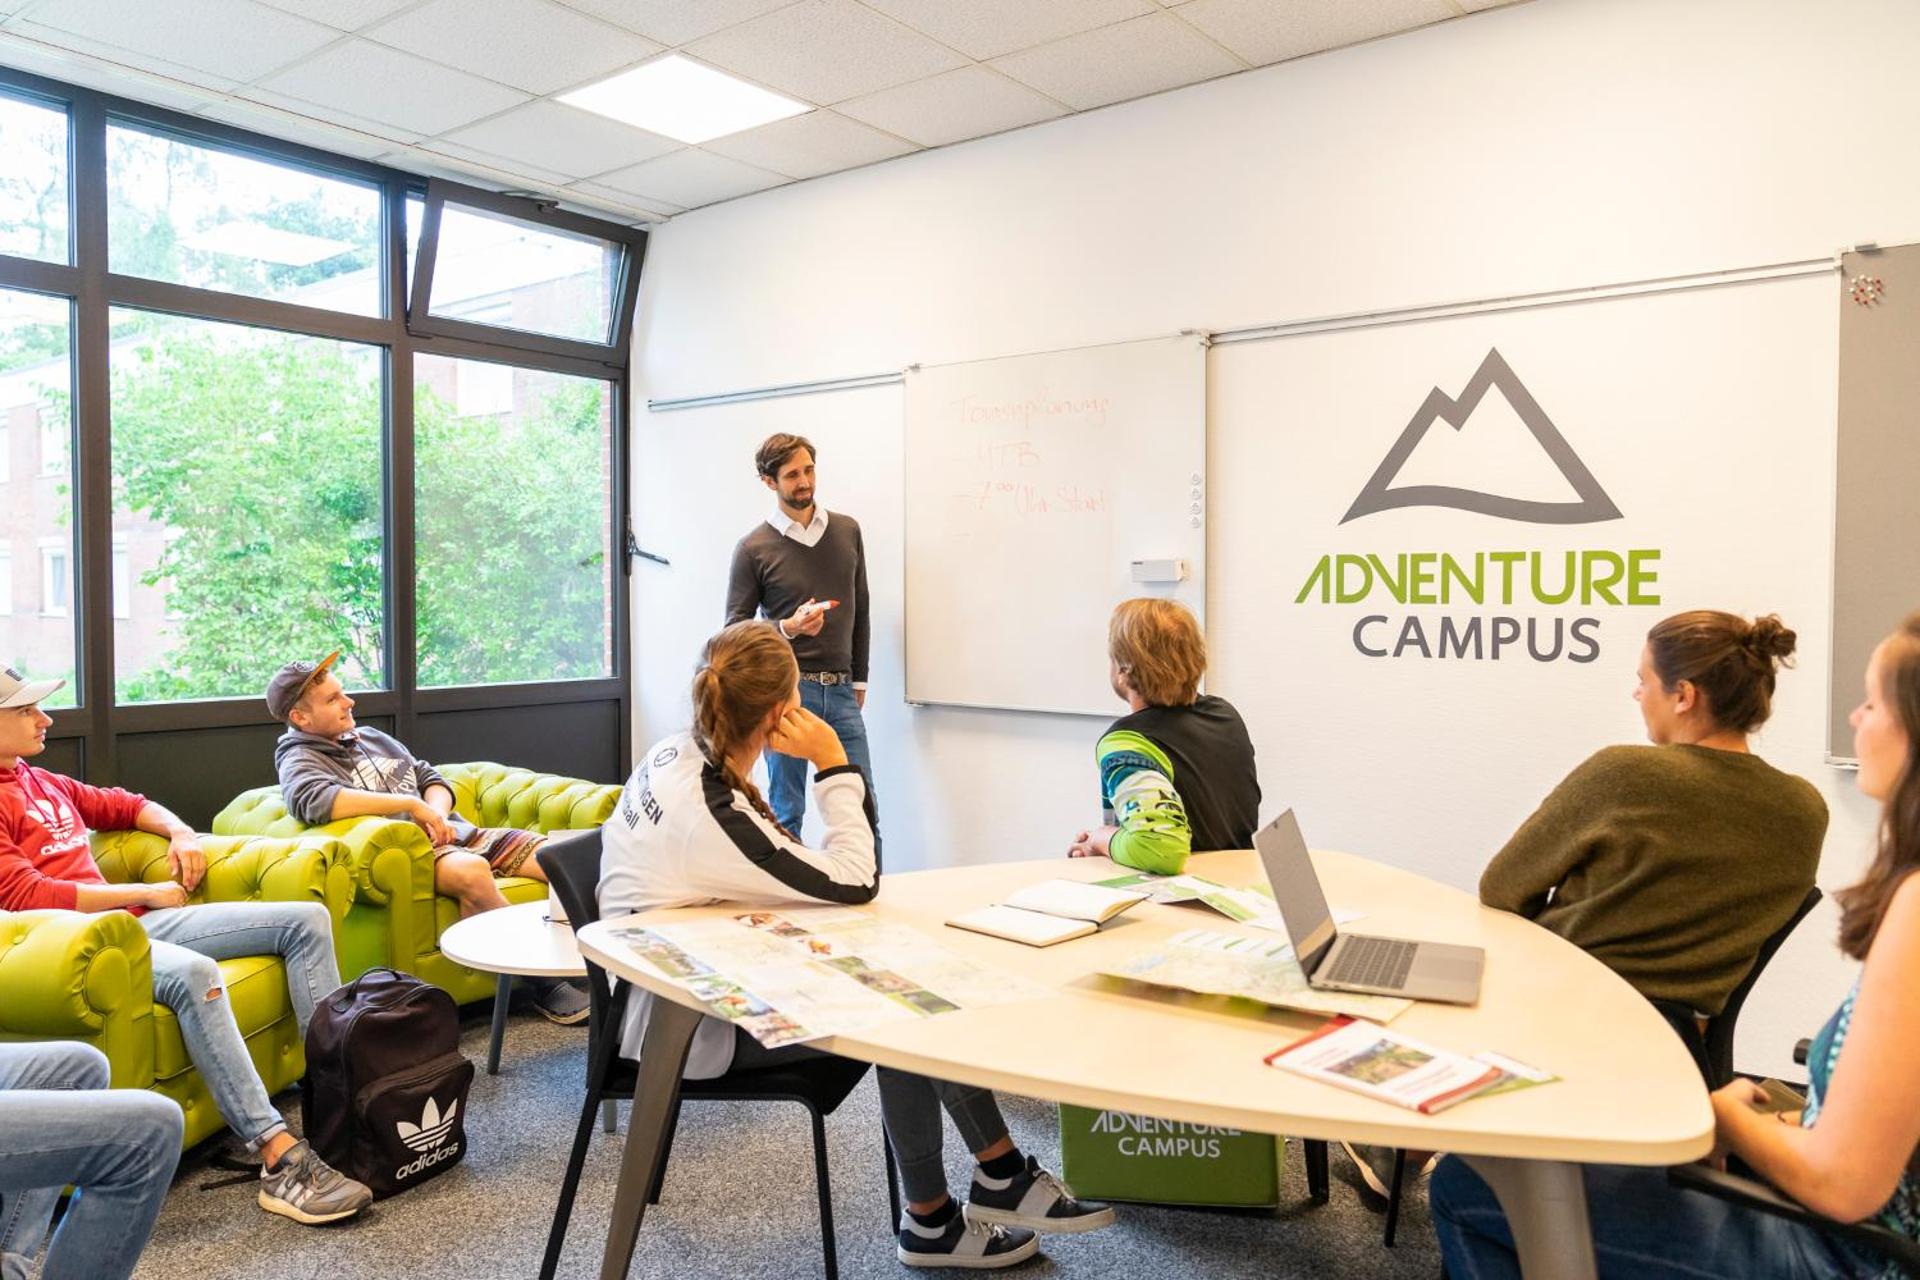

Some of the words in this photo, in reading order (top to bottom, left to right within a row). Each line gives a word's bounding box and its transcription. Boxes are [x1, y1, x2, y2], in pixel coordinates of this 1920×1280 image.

[1294, 549, 1661, 606] ADVENTURE
[1352, 615, 1601, 664] CAMPUS
[395, 1142, 459, 1180] adidas
[1118, 1136, 1221, 1158] CAMPUS
